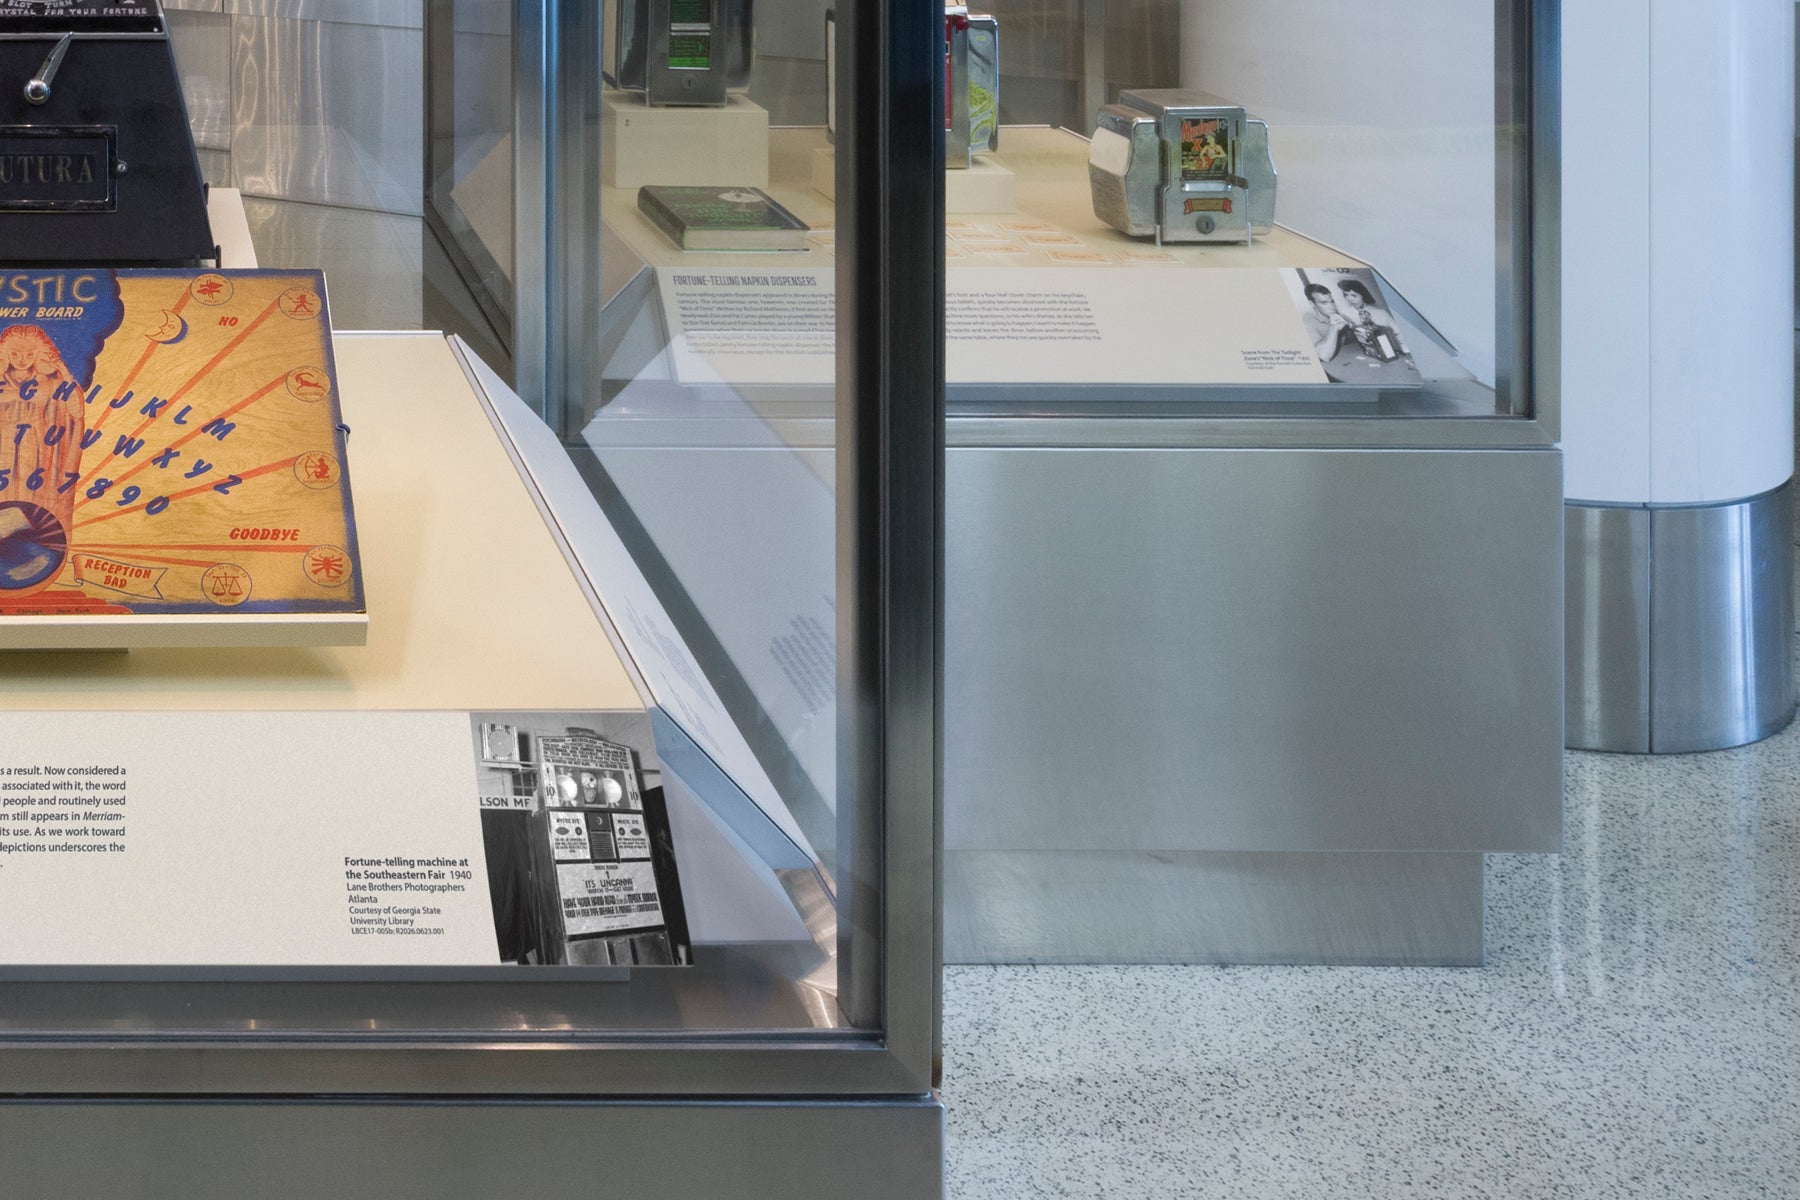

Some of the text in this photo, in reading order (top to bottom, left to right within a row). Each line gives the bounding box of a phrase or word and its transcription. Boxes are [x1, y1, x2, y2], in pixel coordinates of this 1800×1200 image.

[8, 0, 33, 9] SLOT
[44, 0, 73, 9] TURN
[44, 8, 60, 16] FOR
[103, 7, 148, 15] FORTUNE
[672, 275, 817, 287] FORTUNE-TELLING NAPKIN DISPENSERS
[35, 306, 85, 318] BOARD
[218, 315, 239, 327] NO
[19, 379, 39, 401] G
[52, 380, 78, 401] H
[85, 384, 102, 404] I
[109, 390, 134, 409] J
[140, 396, 168, 418] K
[173, 405, 192, 425] L
[201, 417, 236, 441] M
[13, 423, 31, 446] T
[44, 425, 66, 446] U
[80, 428, 102, 450] V
[113, 434, 145, 459] W
[152, 447, 181, 469] X
[184, 458, 213, 479] Y
[213, 474, 243, 495] Z
[26, 468, 45, 491] 6
[57, 472, 81, 494] 7
[86, 478, 114, 499] 8
[116, 485, 141, 506] 9
[145, 496, 170, 516] 0
[229, 527, 301, 542] GOODBYE
[84, 558, 152, 580] RECEPTION
[103, 575, 128, 590] BAD
[11, 811, 29, 821] still
[30, 813, 69, 823] appears
[71, 811, 81, 821] in
[82, 811, 125, 821] Merriam-
[344, 856, 469, 869] Fortune-telling machine at
[345, 870, 472, 880] the Southeastern Fair 1940
[347, 882, 465, 894] Lane Brothers Photographers
[348, 894, 378, 904] Atlanta
[349, 906, 441, 916] Courtesy of Georgia State
[350, 917, 414, 927] University Library
